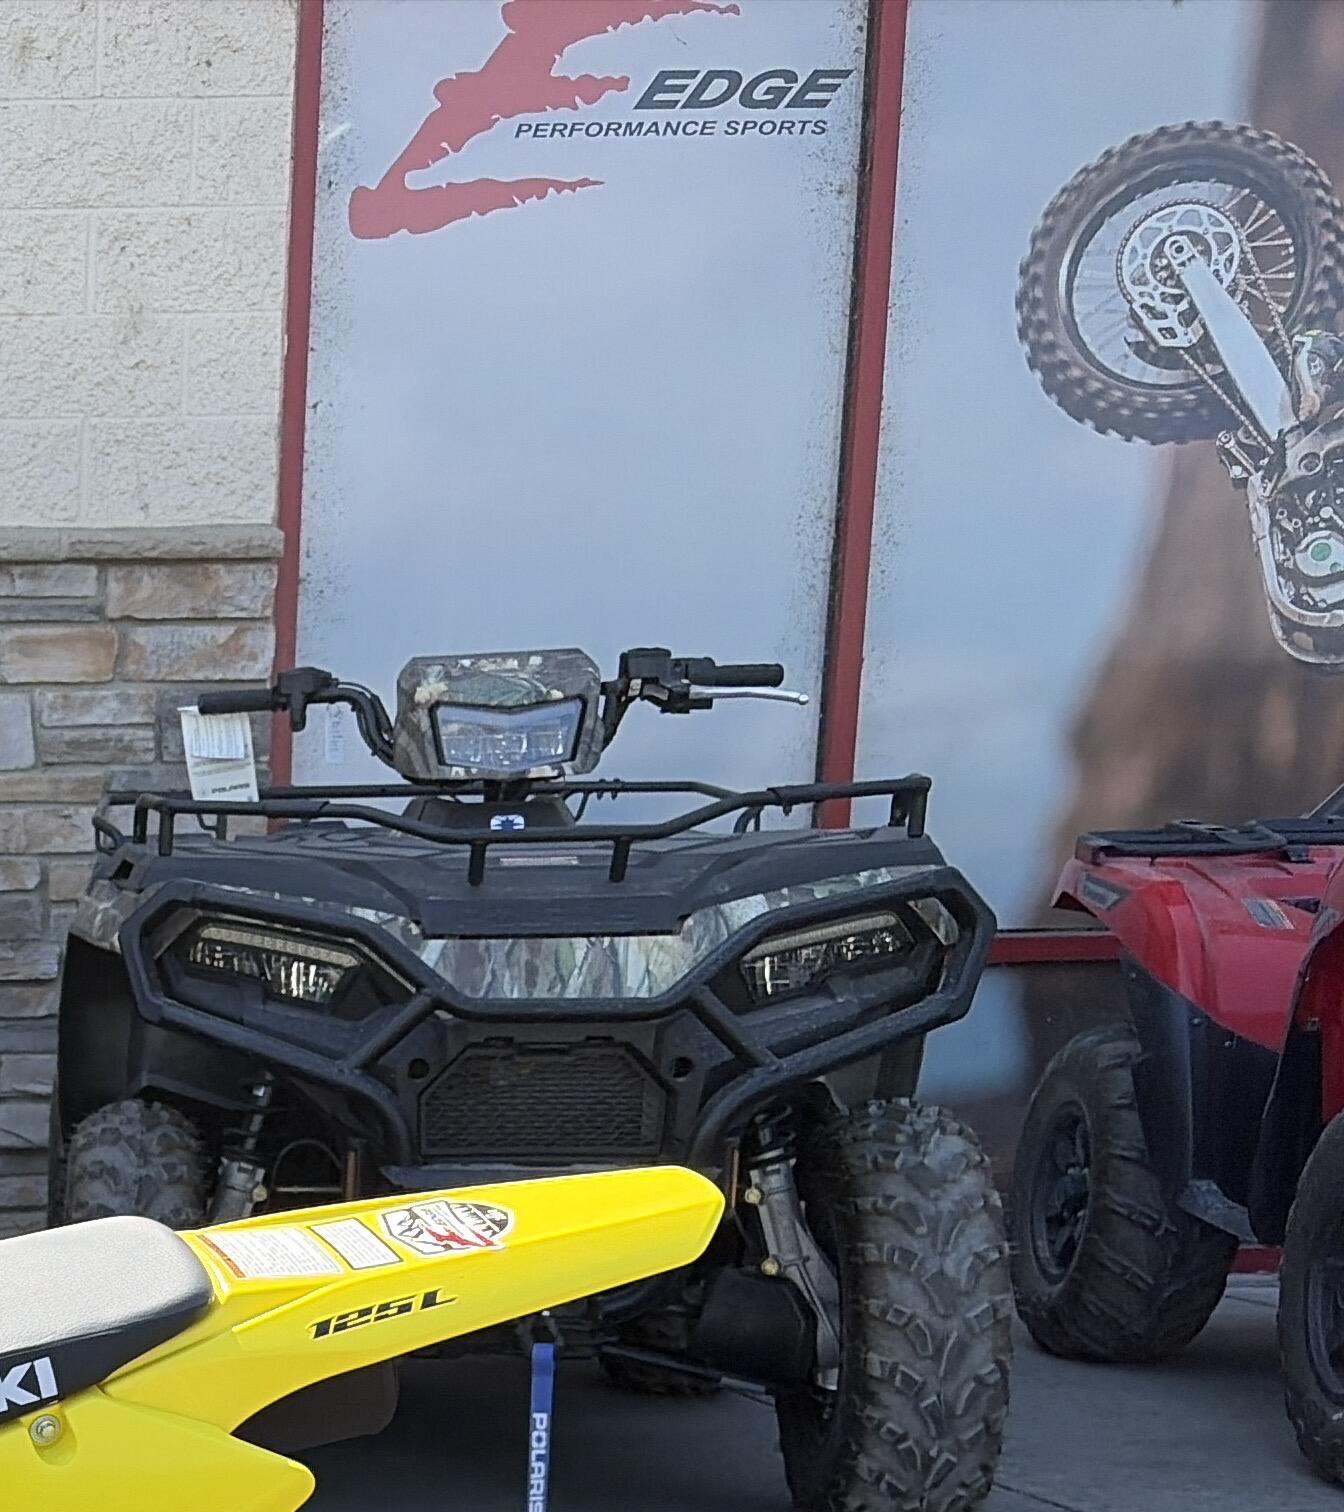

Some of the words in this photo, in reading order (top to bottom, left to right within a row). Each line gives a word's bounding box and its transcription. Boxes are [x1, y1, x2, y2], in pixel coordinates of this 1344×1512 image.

[633, 69, 854, 110] EDGE
[514, 120, 717, 139] PERFORMANCE
[723, 119, 827, 136] SPORTS
[309, 1287, 458, 1340] 125L
